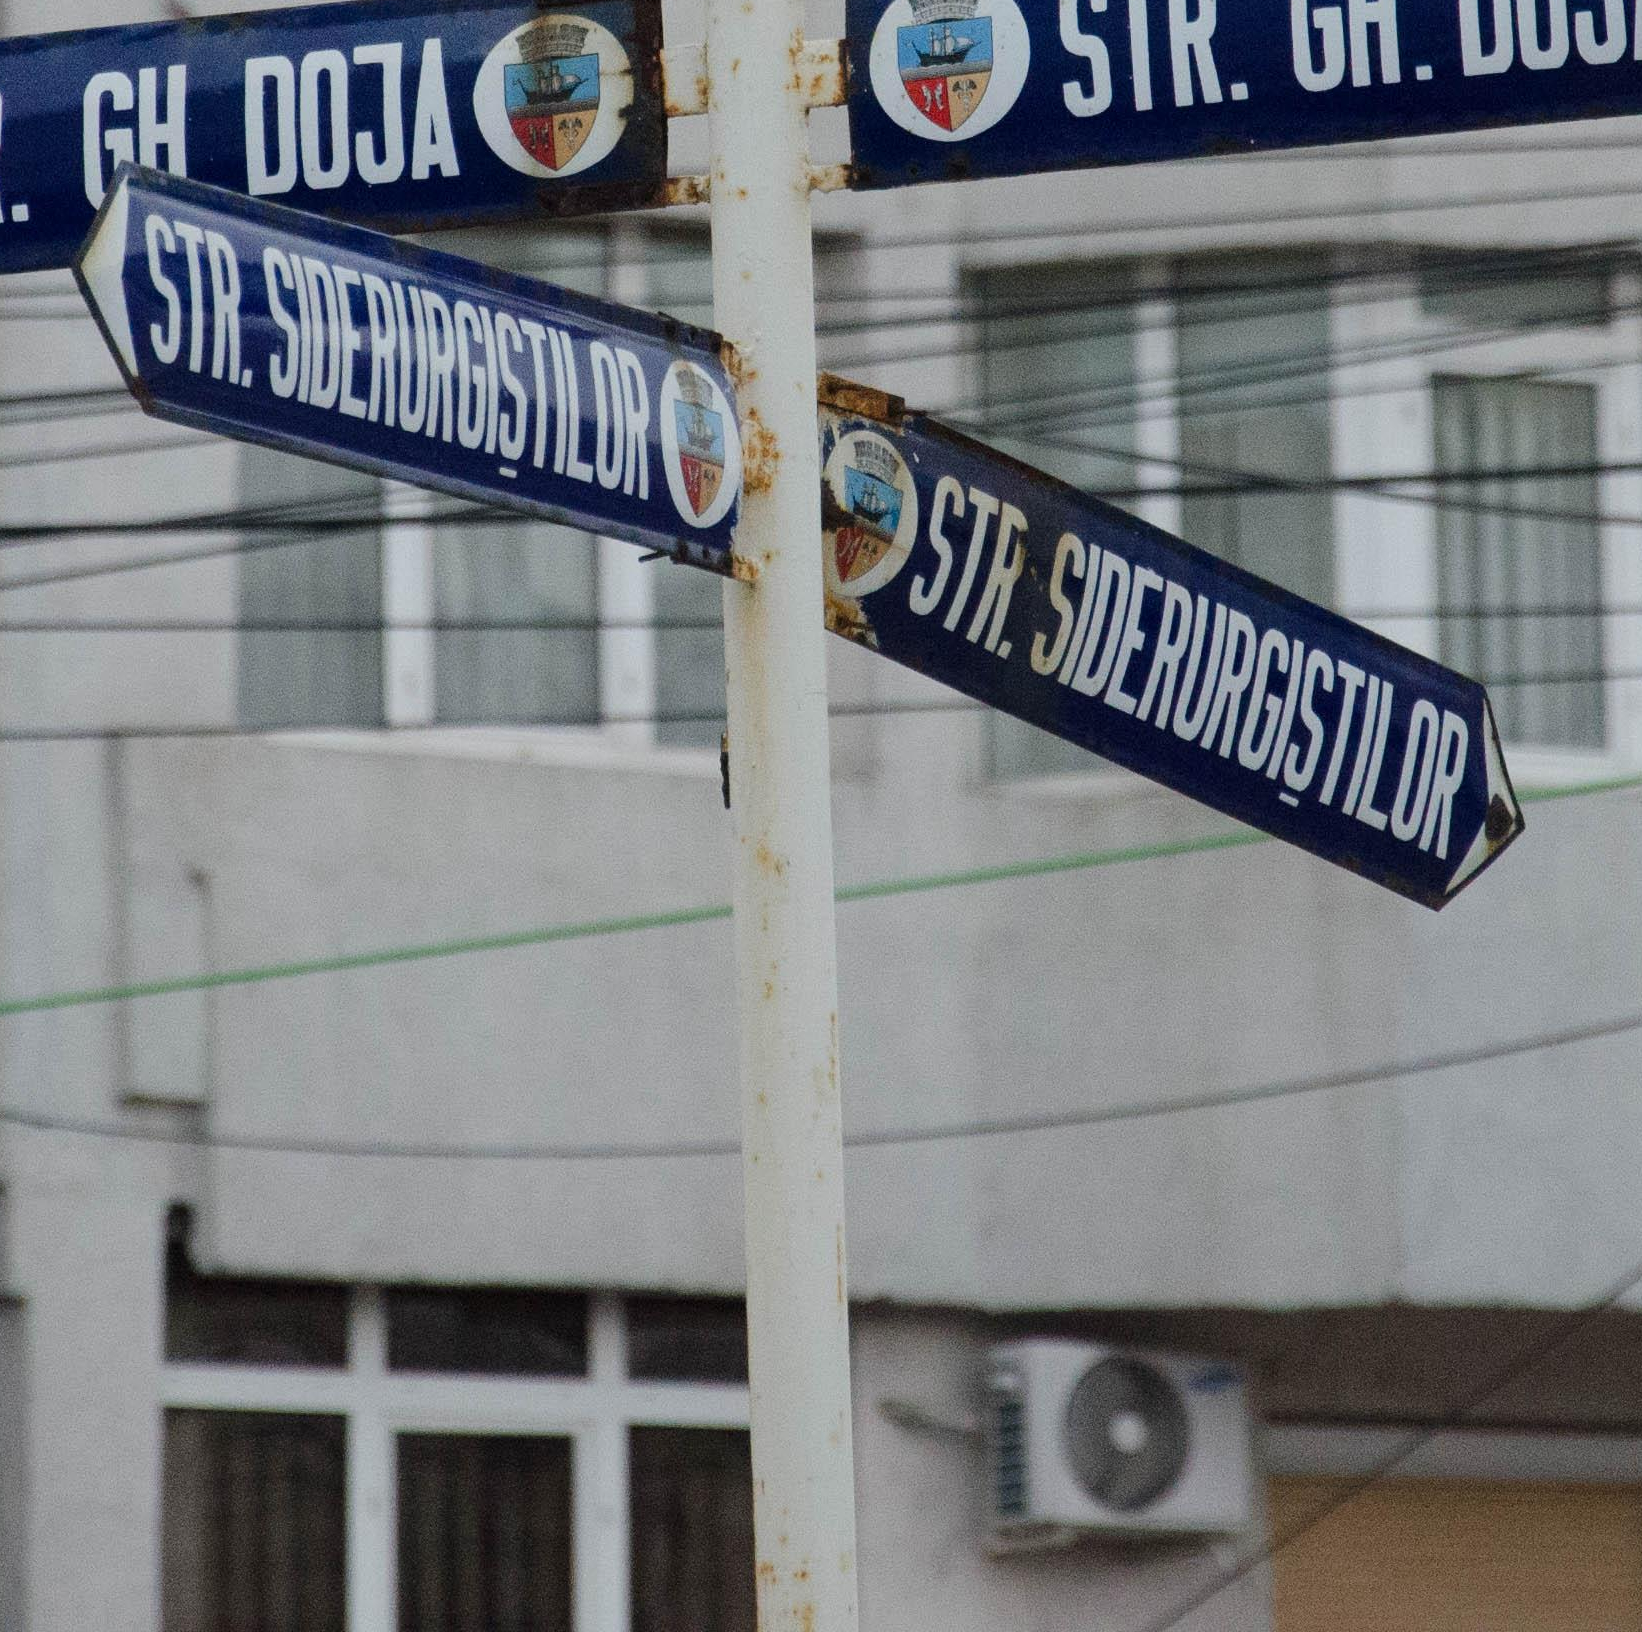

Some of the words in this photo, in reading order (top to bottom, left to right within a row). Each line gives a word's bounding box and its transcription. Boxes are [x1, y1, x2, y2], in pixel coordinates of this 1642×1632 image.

[82, 63, 188, 211] GH
[244, 37, 460, 196] DOJA
[147, 213, 253, 388] STR.
[909, 474, 1029, 660] STR.
